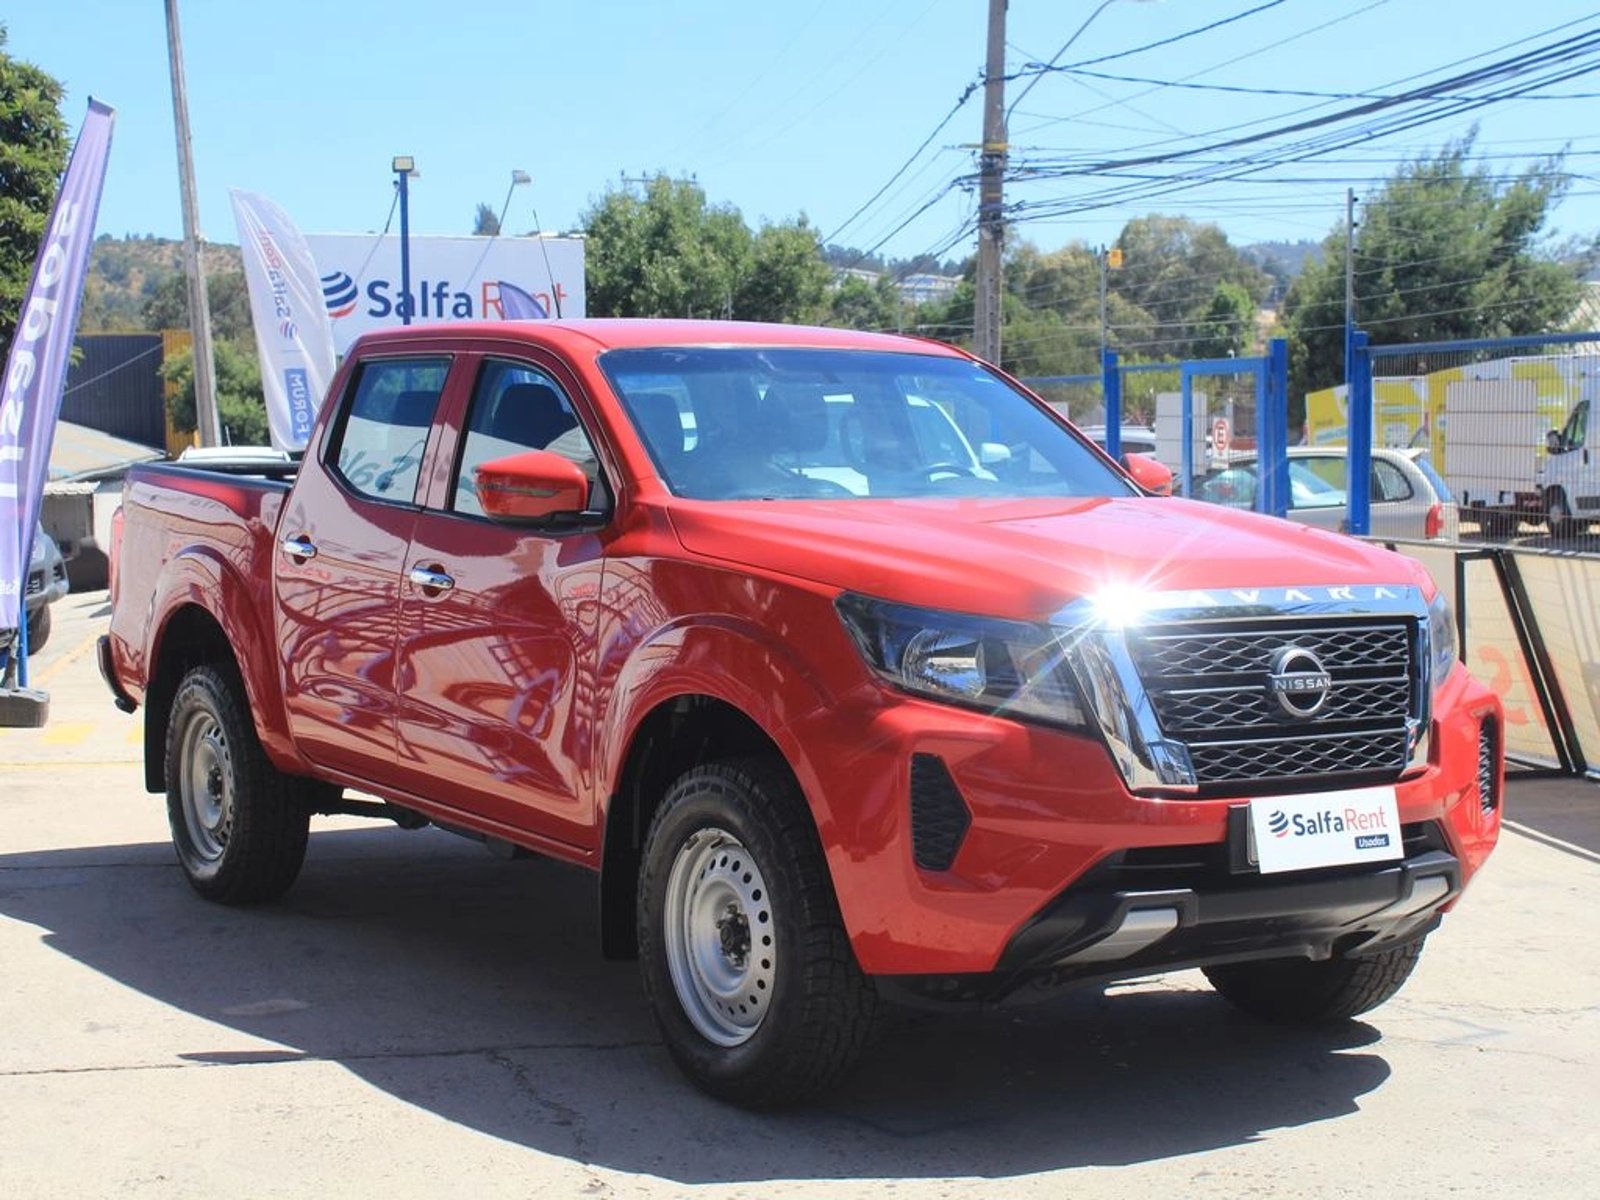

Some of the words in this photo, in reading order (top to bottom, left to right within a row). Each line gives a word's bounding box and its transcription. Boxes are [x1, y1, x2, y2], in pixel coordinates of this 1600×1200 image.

[1143, 585, 1398, 606] AVARA
[1274, 673, 1332, 690] NISSAN
[1292, 806, 1387, 836] SalfaRent
